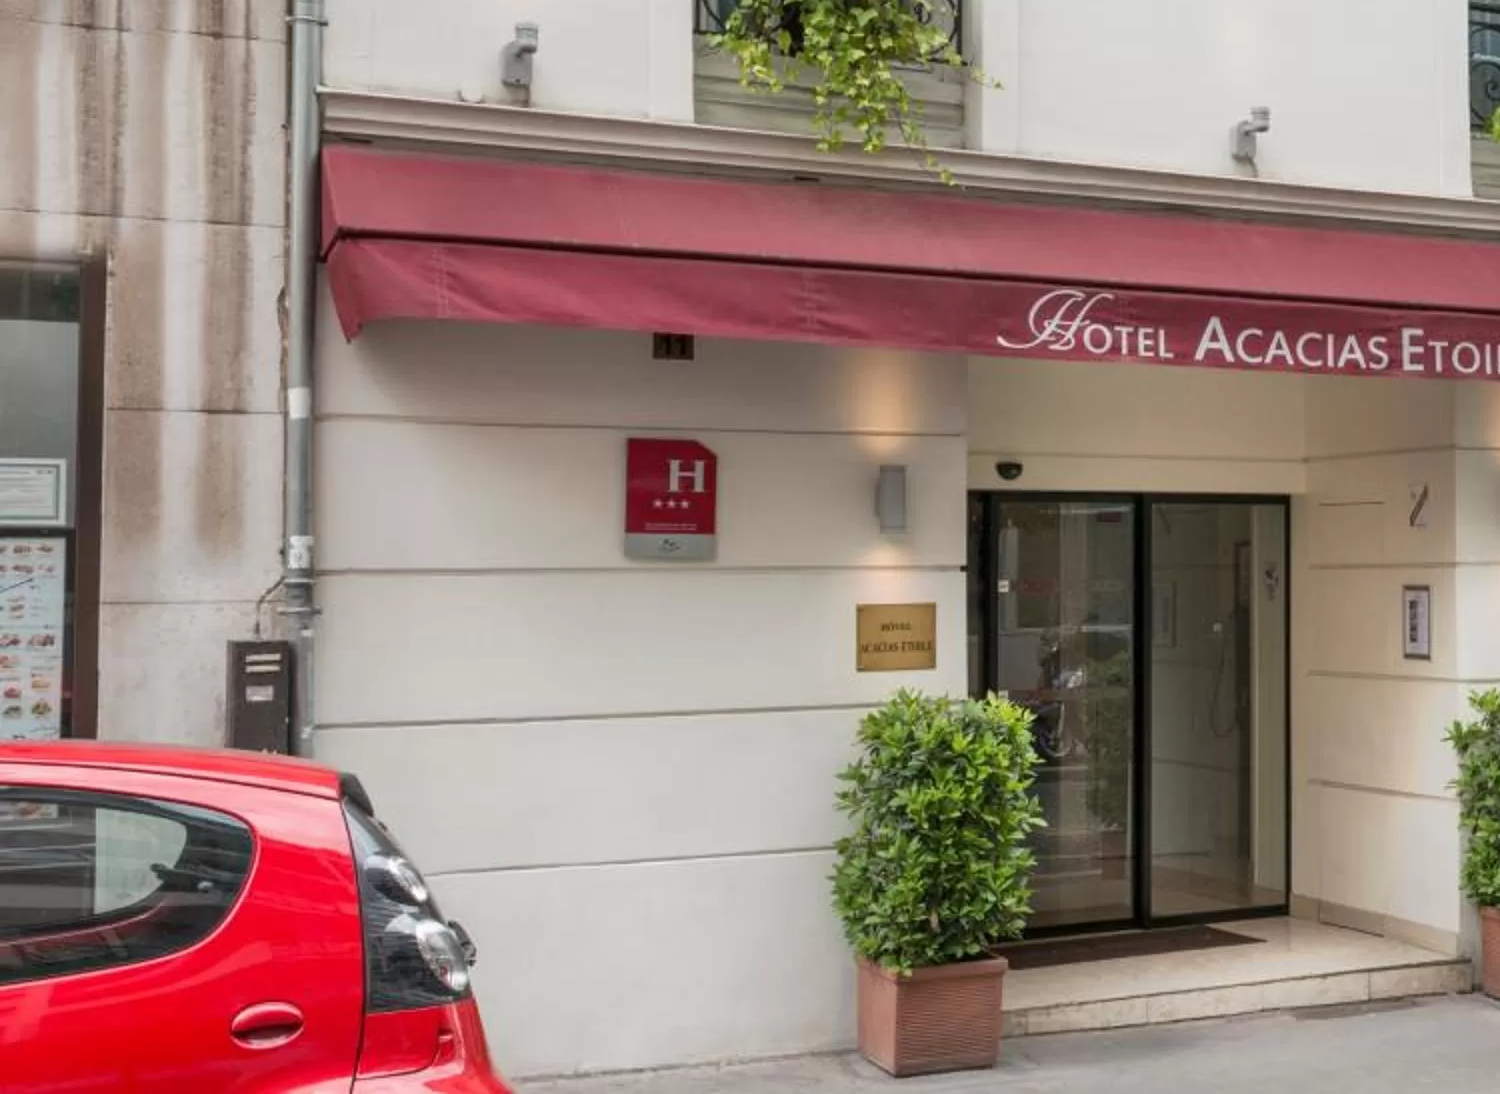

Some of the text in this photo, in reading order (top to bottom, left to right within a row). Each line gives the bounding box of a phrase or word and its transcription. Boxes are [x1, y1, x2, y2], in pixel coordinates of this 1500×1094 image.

[997, 289, 1174, 358] HOTEL
[1194, 317, 1389, 371] ACACIAS
[667, 459, 706, 492] H
